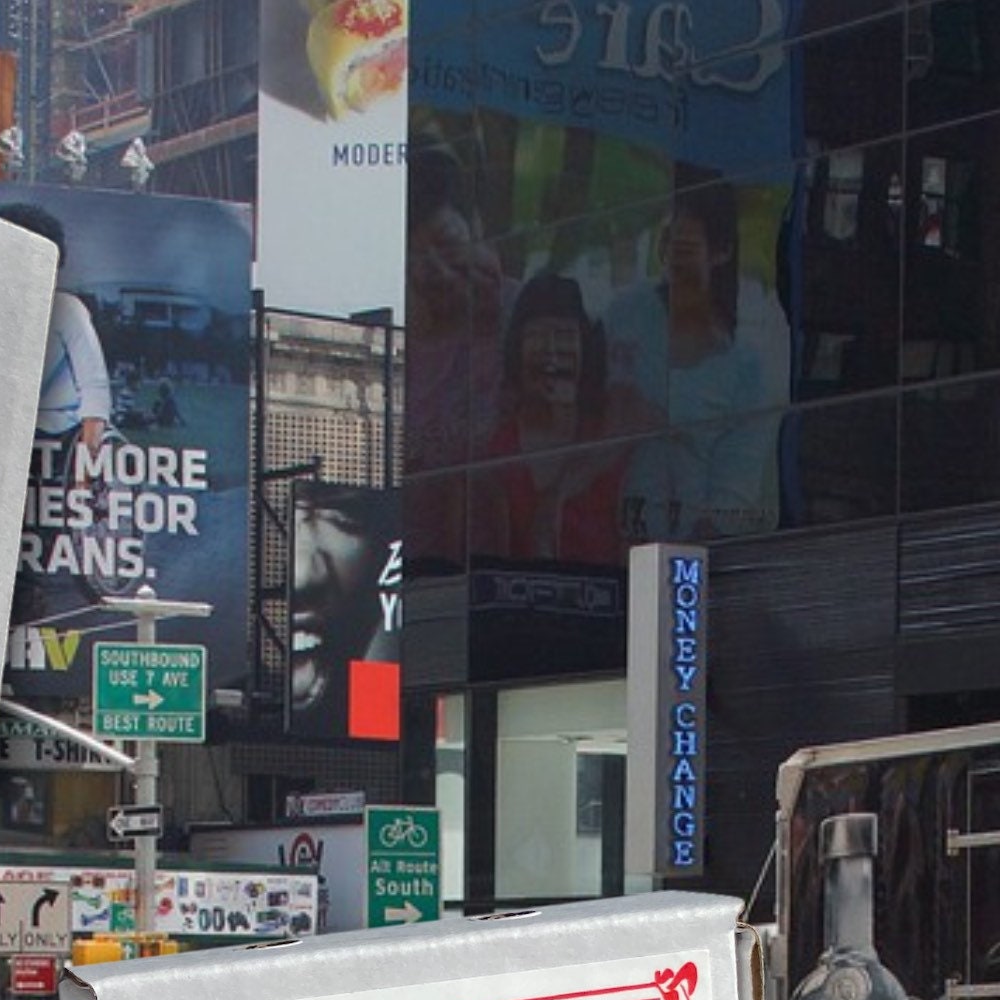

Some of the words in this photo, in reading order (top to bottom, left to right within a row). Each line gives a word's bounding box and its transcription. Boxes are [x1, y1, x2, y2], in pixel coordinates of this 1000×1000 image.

[75, 441, 208, 490] MORE
[108, 491, 199, 536] FOR
[672, 558, 699, 692] MONEY
[101, 650, 200, 669] SOUTHBOUND
[109, 670, 138, 687] USE
[146, 670, 156, 686] 7
[162, 671, 190, 687] AVE
[103, 714, 139, 732] BEST
[148, 716, 195, 733] ROUTE
[672, 702, 698, 866] CHANGE
[371, 859, 391, 874] Alt
[396, 860, 440, 876] Route
[376, 877, 434, 896] South
[25, 932, 68, 946] ONLY
